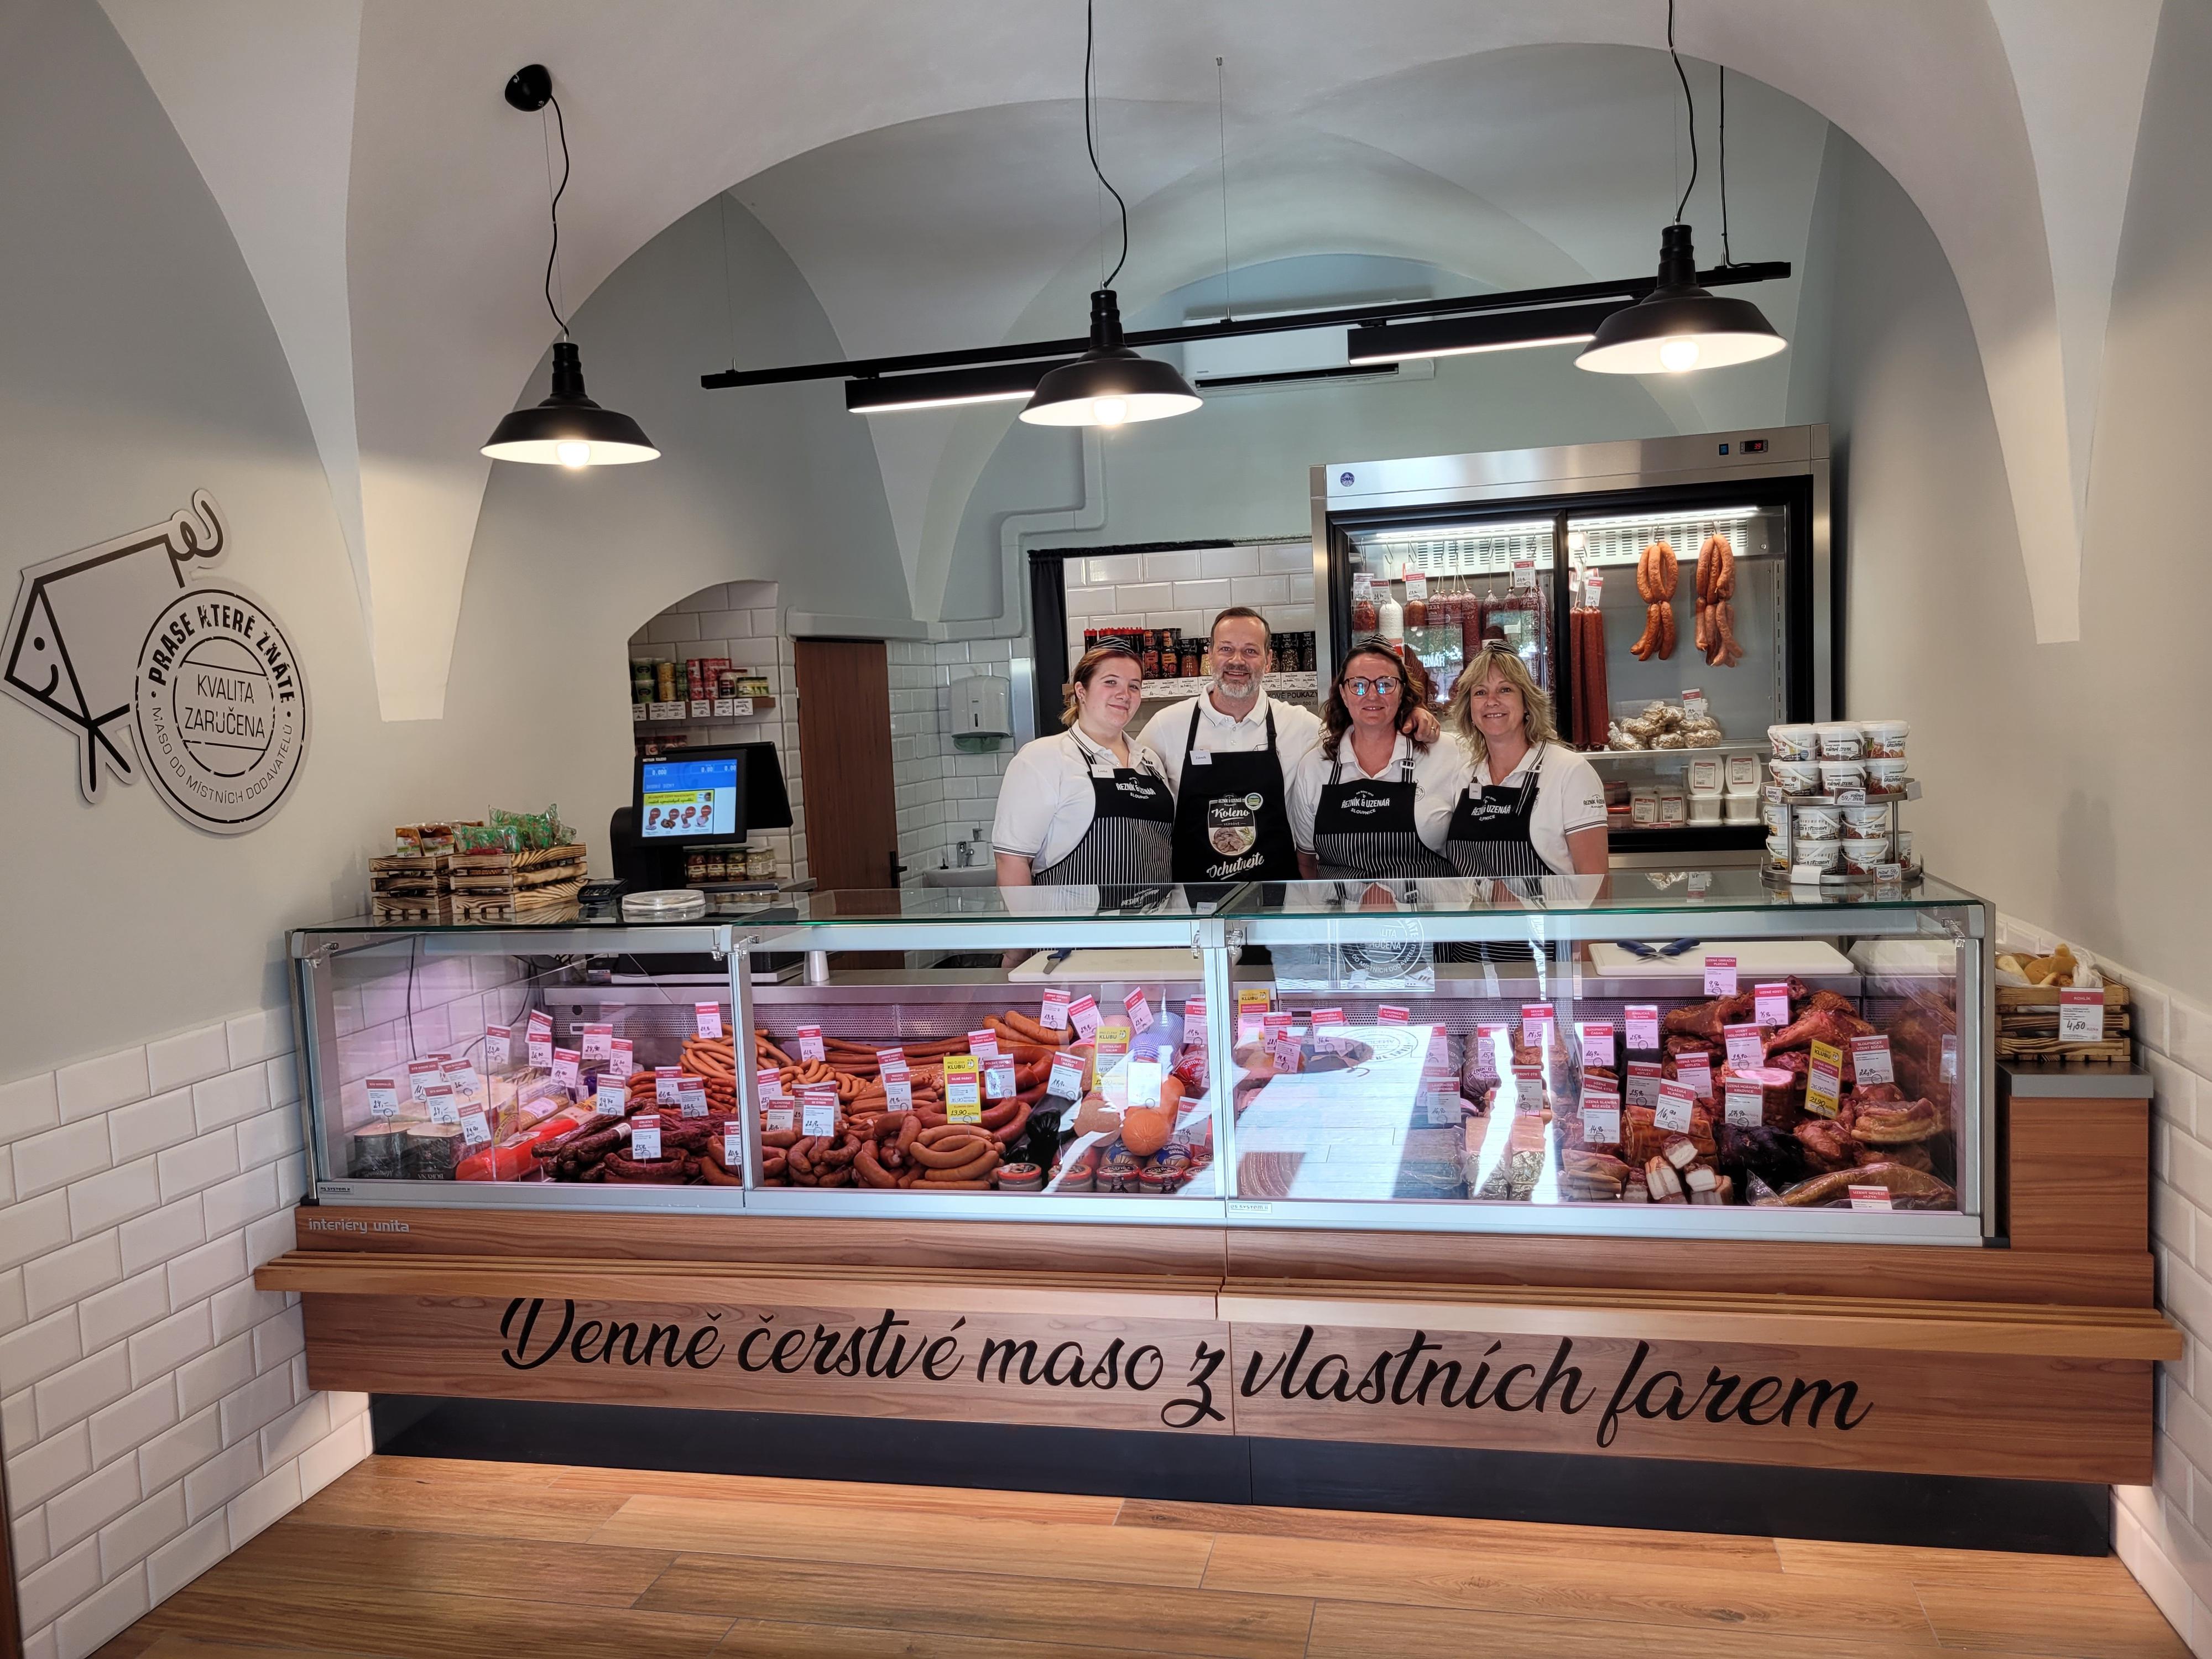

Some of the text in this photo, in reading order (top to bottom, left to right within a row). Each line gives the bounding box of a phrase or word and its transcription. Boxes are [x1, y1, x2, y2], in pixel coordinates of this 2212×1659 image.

[148, 604, 295, 703] PRASE KTERÉ ZNÁTE
[197, 673, 254, 705] KVALITA
[184, 706, 265, 739] ZARUČENA
[152, 707, 293, 805] MASO OD MÍSTNÍCH DODAVATELŮ
[1211, 807, 1250, 818] Koleno
[1341, 797, 1360, 808] ŘEZNÍK
[1365, 798, 1390, 807] UZENÁŘ
[1486, 805, 1511, 814] UZENÁŘ
[1206, 852, 1265, 878] Ochutnejte
[2067, 1020, 2085, 1031] 4,50
[1814, 1049, 1831, 1060] KLUBU
[309, 1218, 410, 1234] interiéry unita
[500, 1297, 1874, 1448] Denně čerstvé maso z vlastních farem
